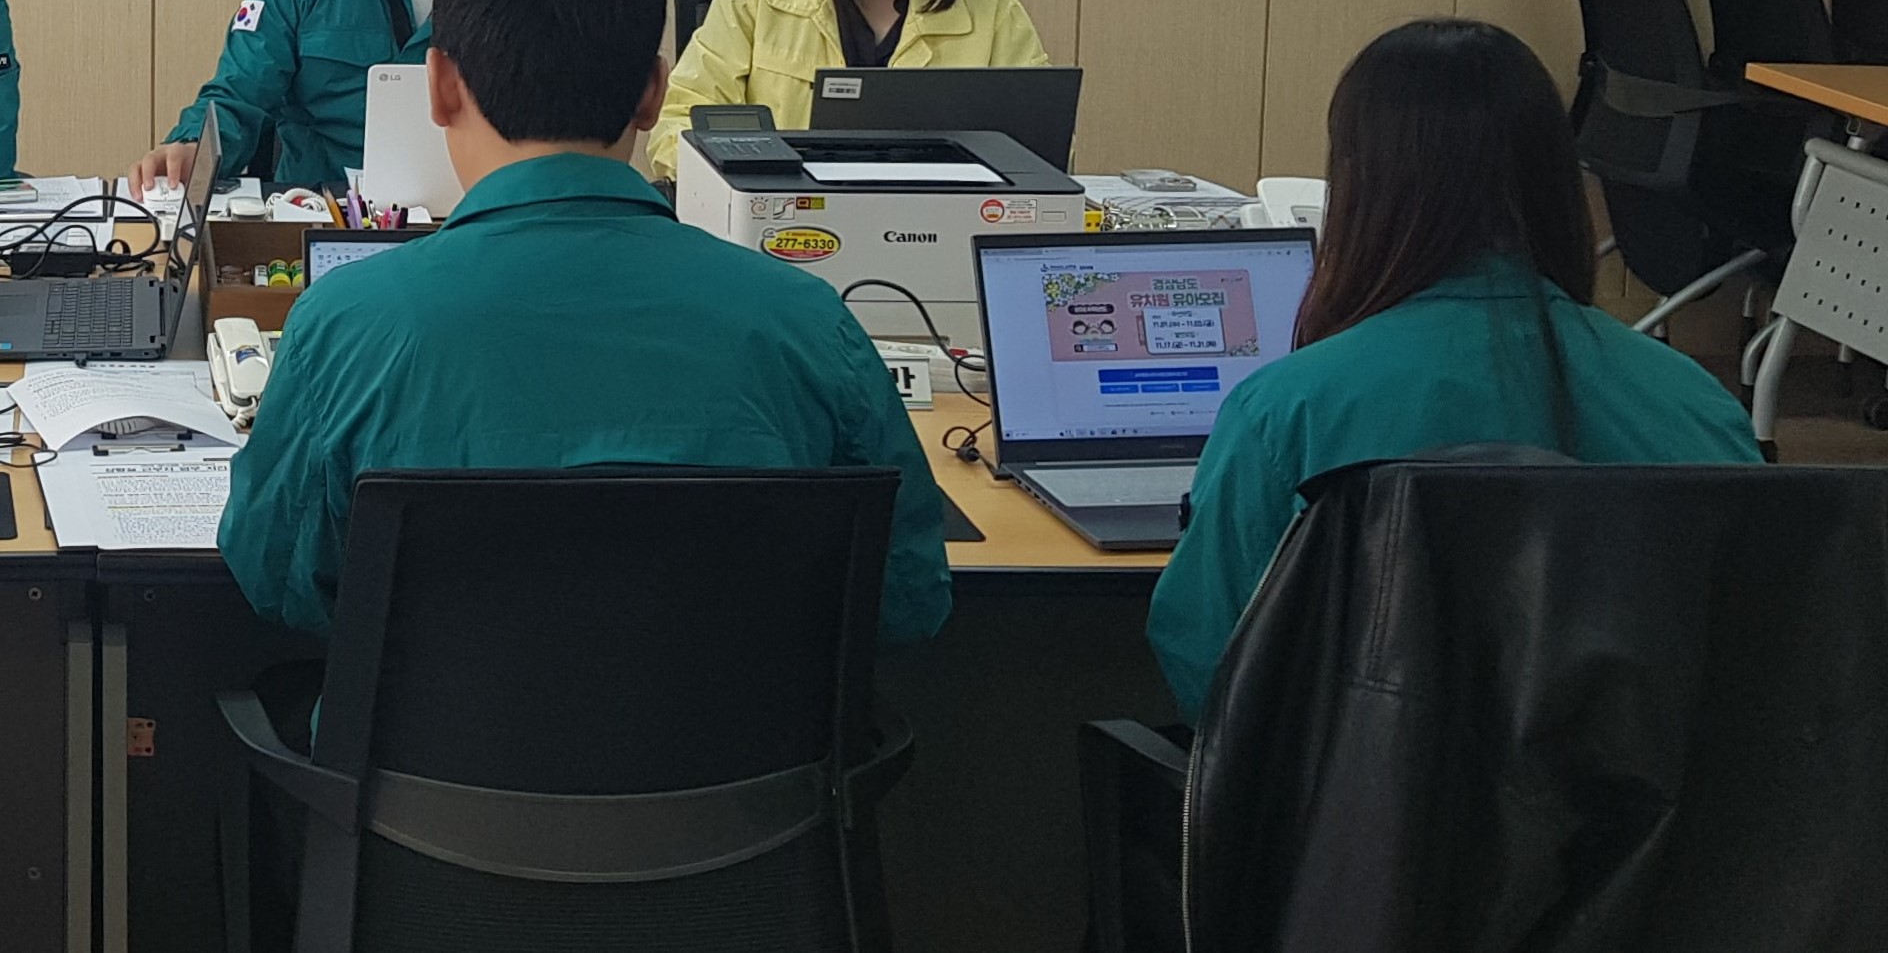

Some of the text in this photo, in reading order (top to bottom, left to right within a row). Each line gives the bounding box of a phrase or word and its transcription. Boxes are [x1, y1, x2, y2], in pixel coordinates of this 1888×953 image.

[884, 231, 937, 242] Canon
[775, 238, 835, 250] 277-6330
[1130, 292, 1225, 308] 유치원 유아모집
